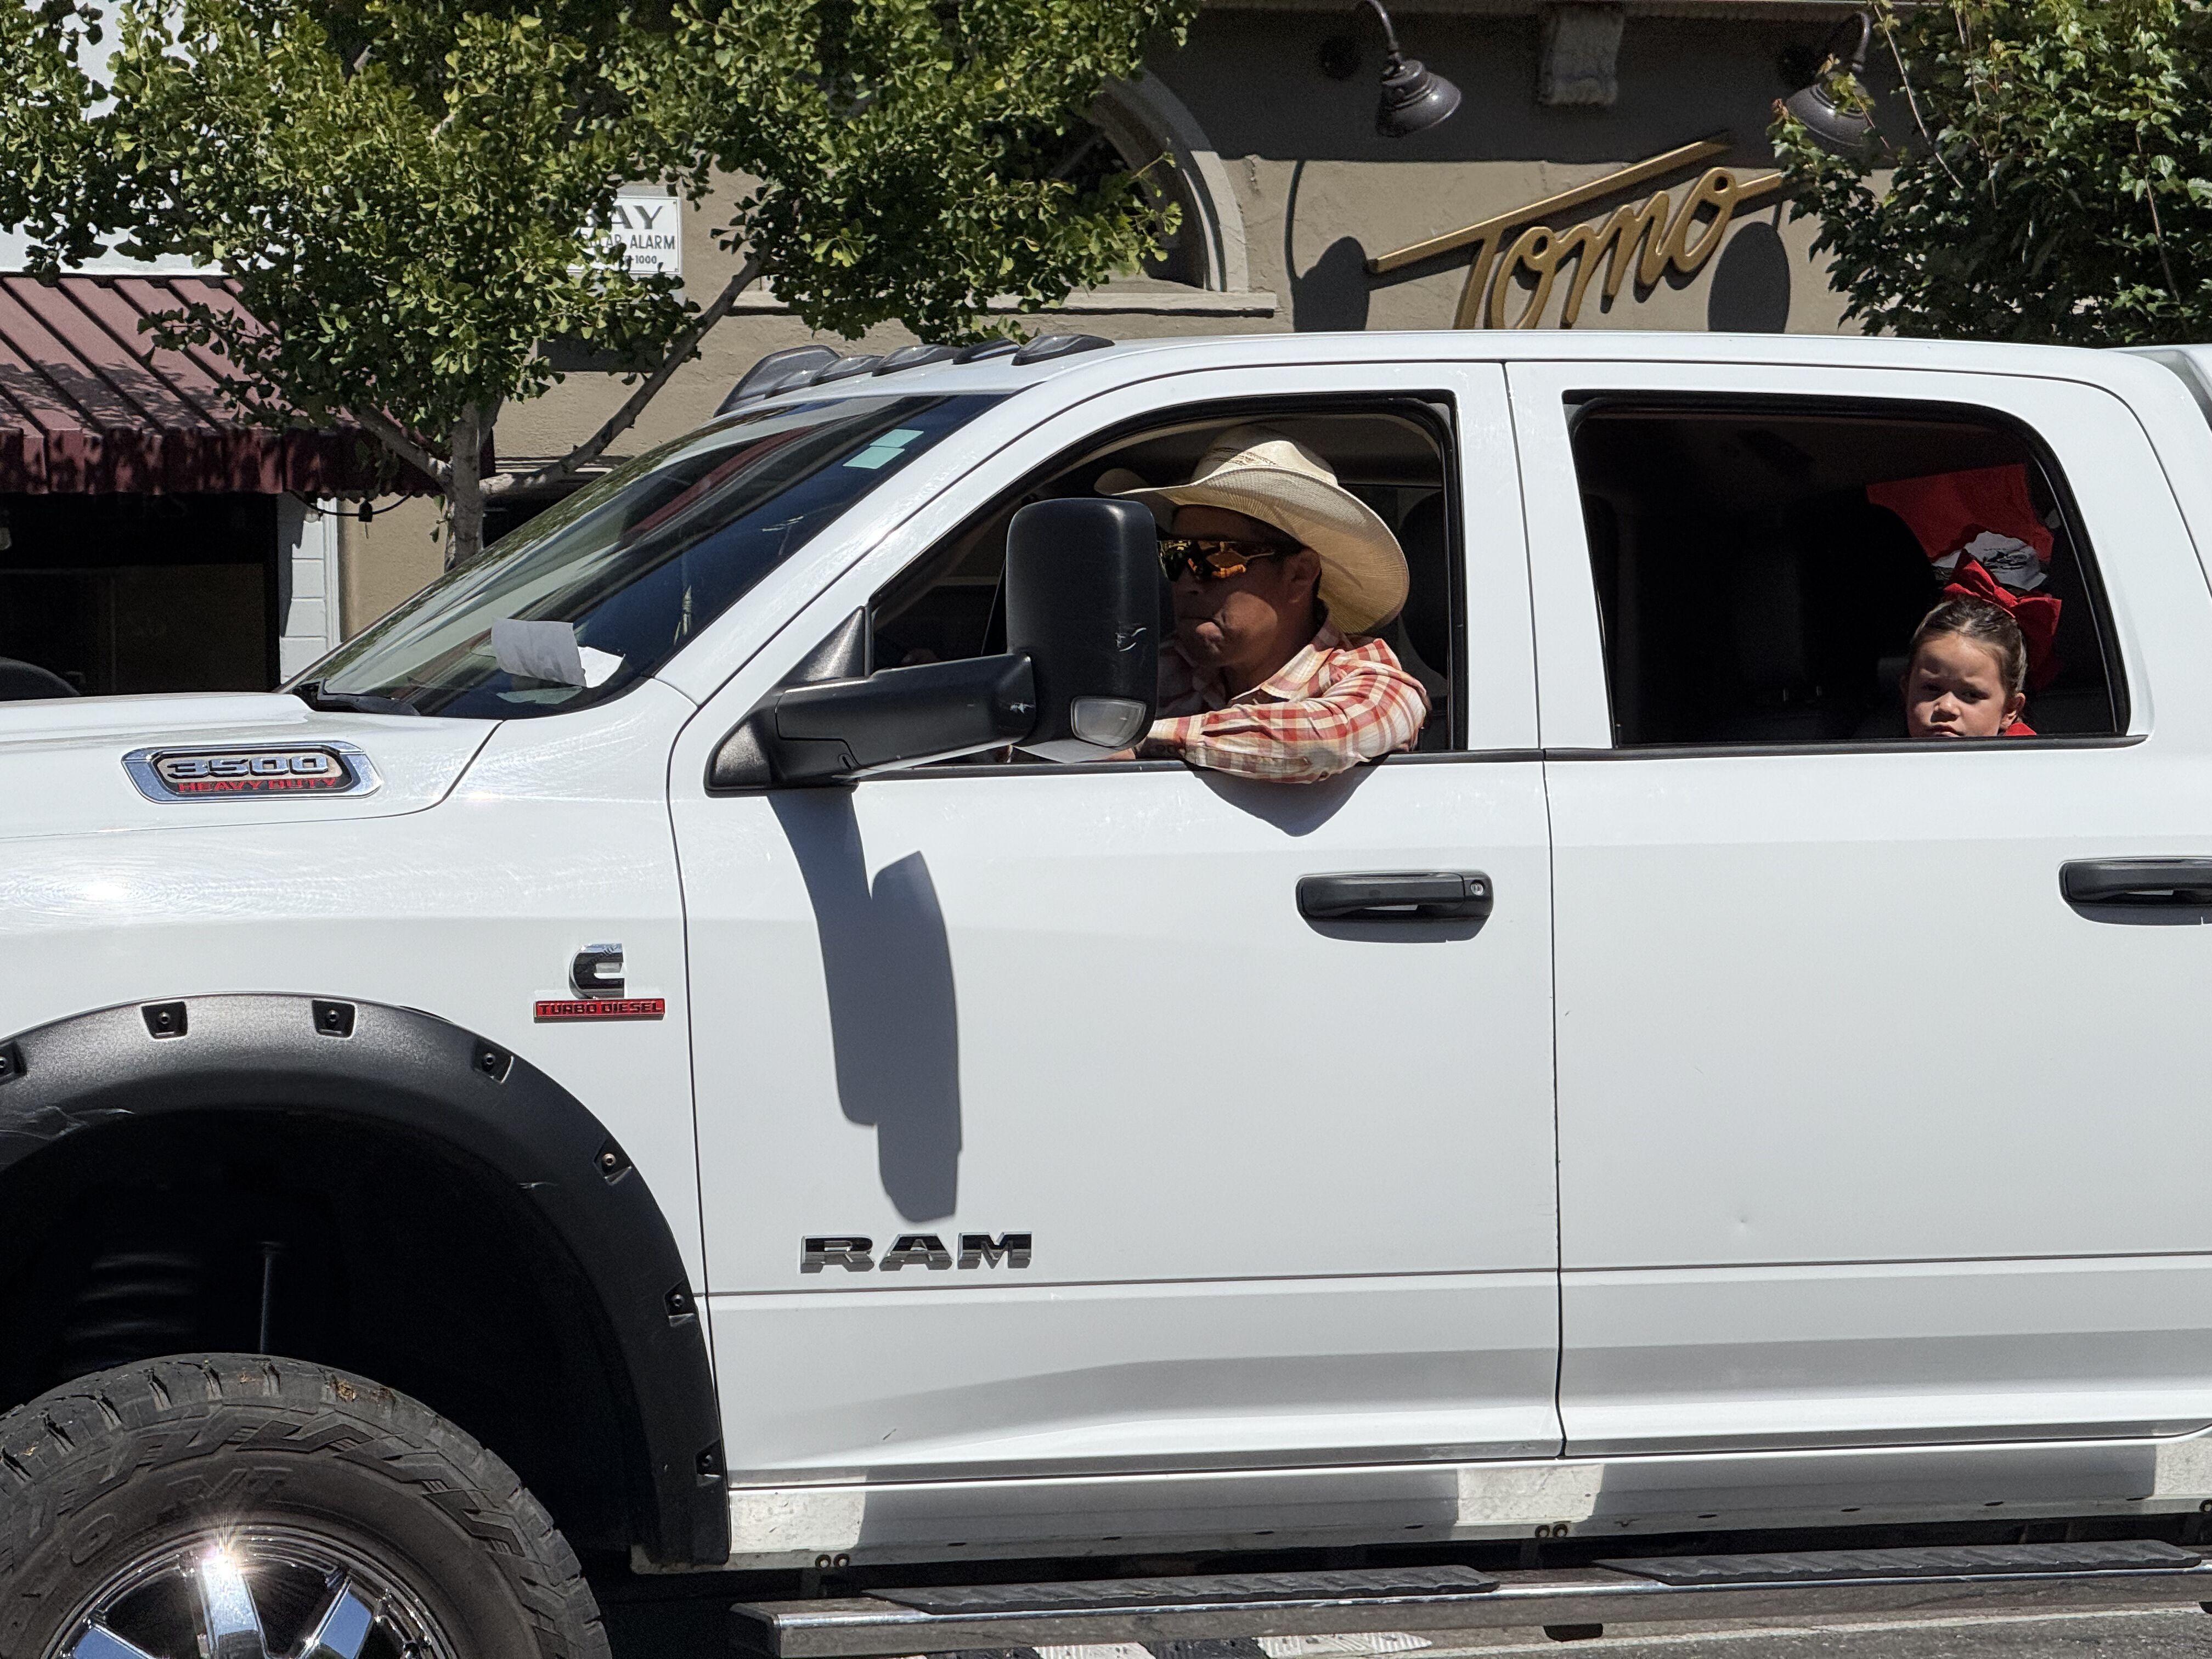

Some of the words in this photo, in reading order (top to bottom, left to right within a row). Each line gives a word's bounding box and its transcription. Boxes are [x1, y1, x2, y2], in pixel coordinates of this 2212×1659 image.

[591, 205, 663, 229] AY
[630, 235, 675, 250] ALARM
[1367, 139, 1787, 330] Tomo
[624, 255, 657, 264] -1000
[167, 757, 329, 778] 3500
[178, 780, 264, 792] HEAVY
[268, 777, 337, 789] DUTY
[539, 1002, 597, 1015] TURBO
[601, 1001, 663, 1013] DIESEL
[800, 1232, 1032, 1273] RAM
